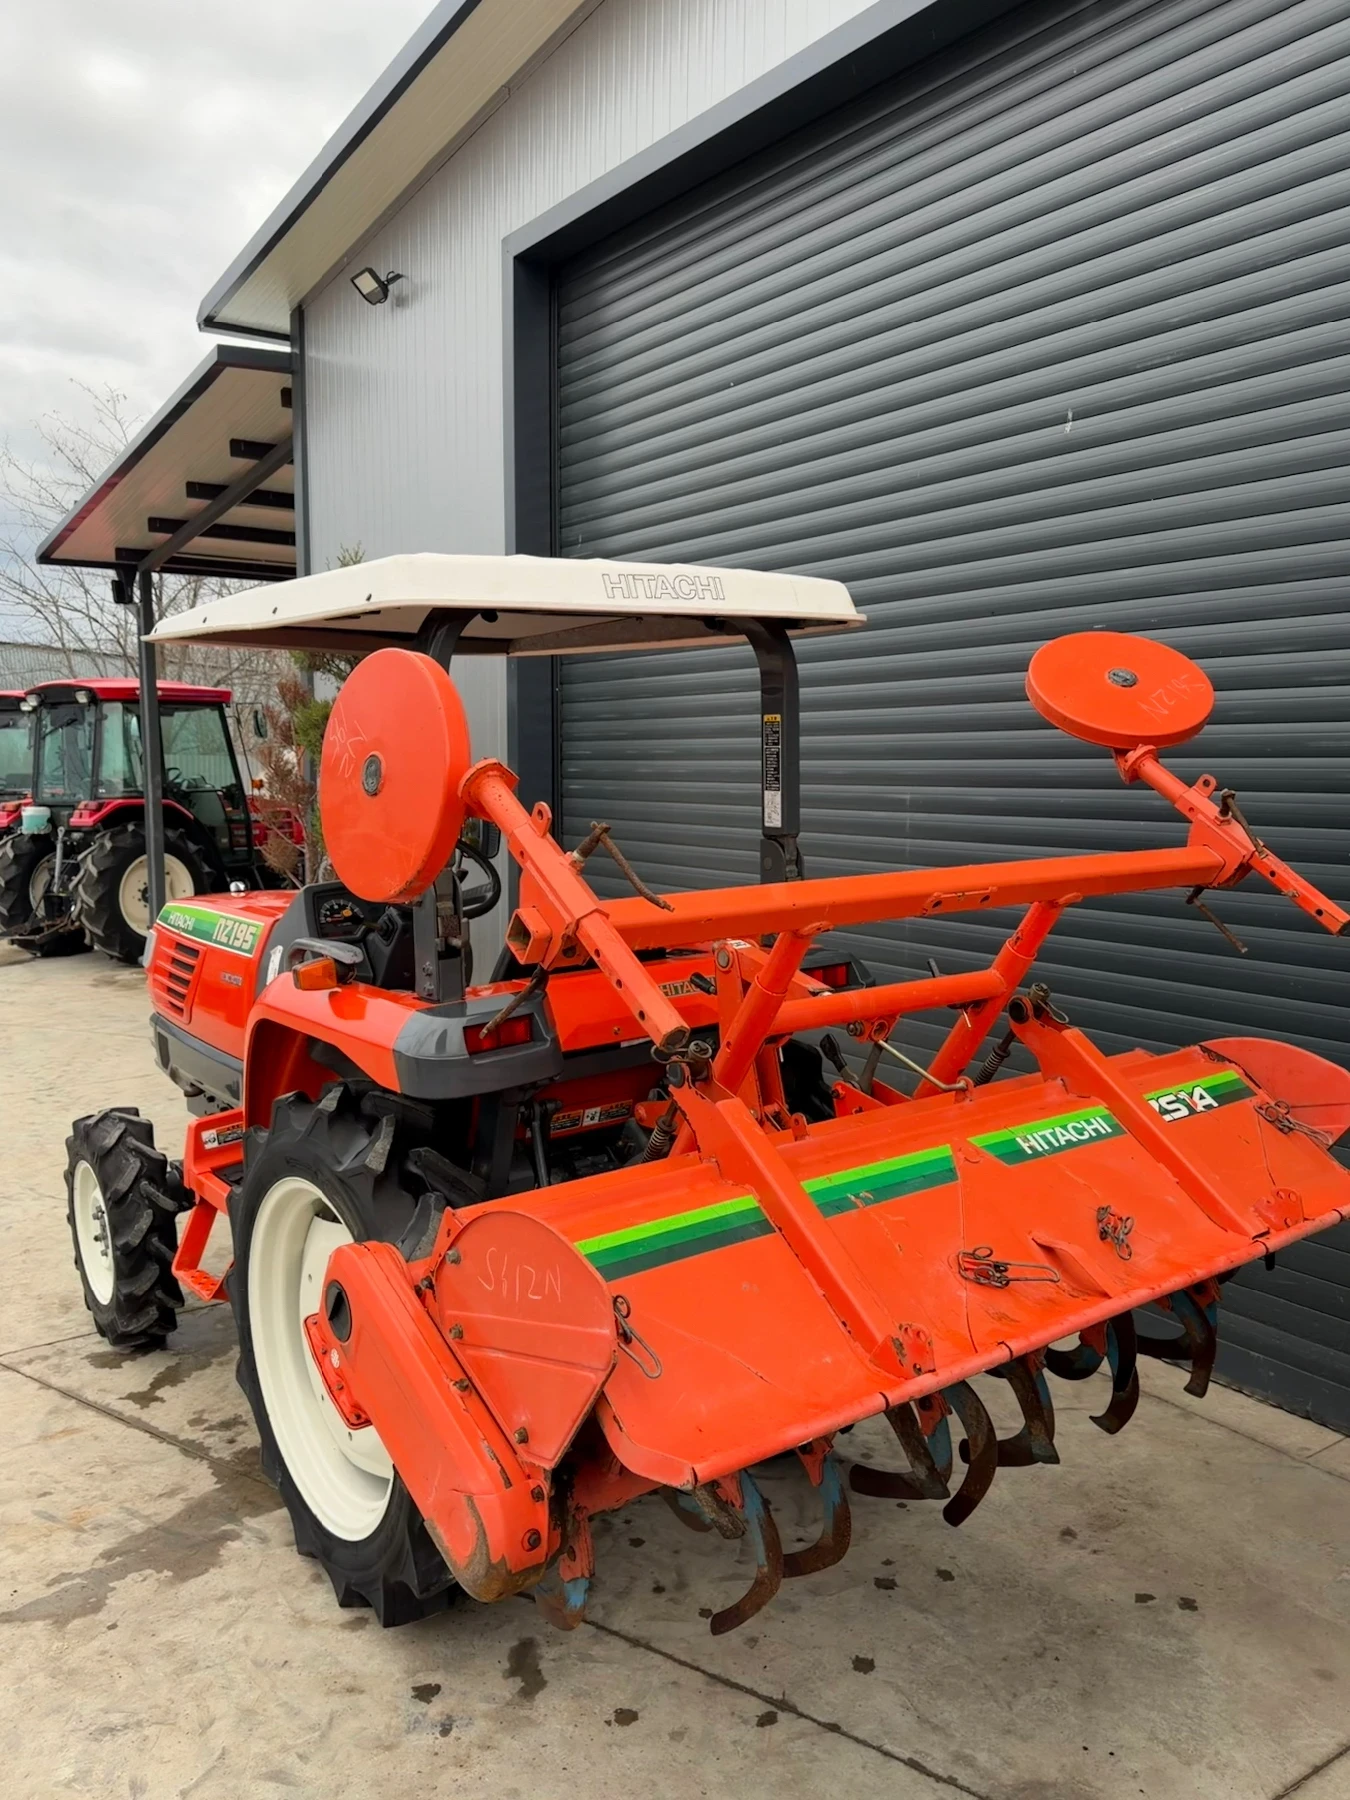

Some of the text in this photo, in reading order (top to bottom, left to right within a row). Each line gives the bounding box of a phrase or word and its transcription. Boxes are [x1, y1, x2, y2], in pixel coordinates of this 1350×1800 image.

[601, 573, 725, 600] HITACHI
[167, 911, 258, 950] HITACHI NZ195
[1015, 1116, 1113, 1154] HITACHI
